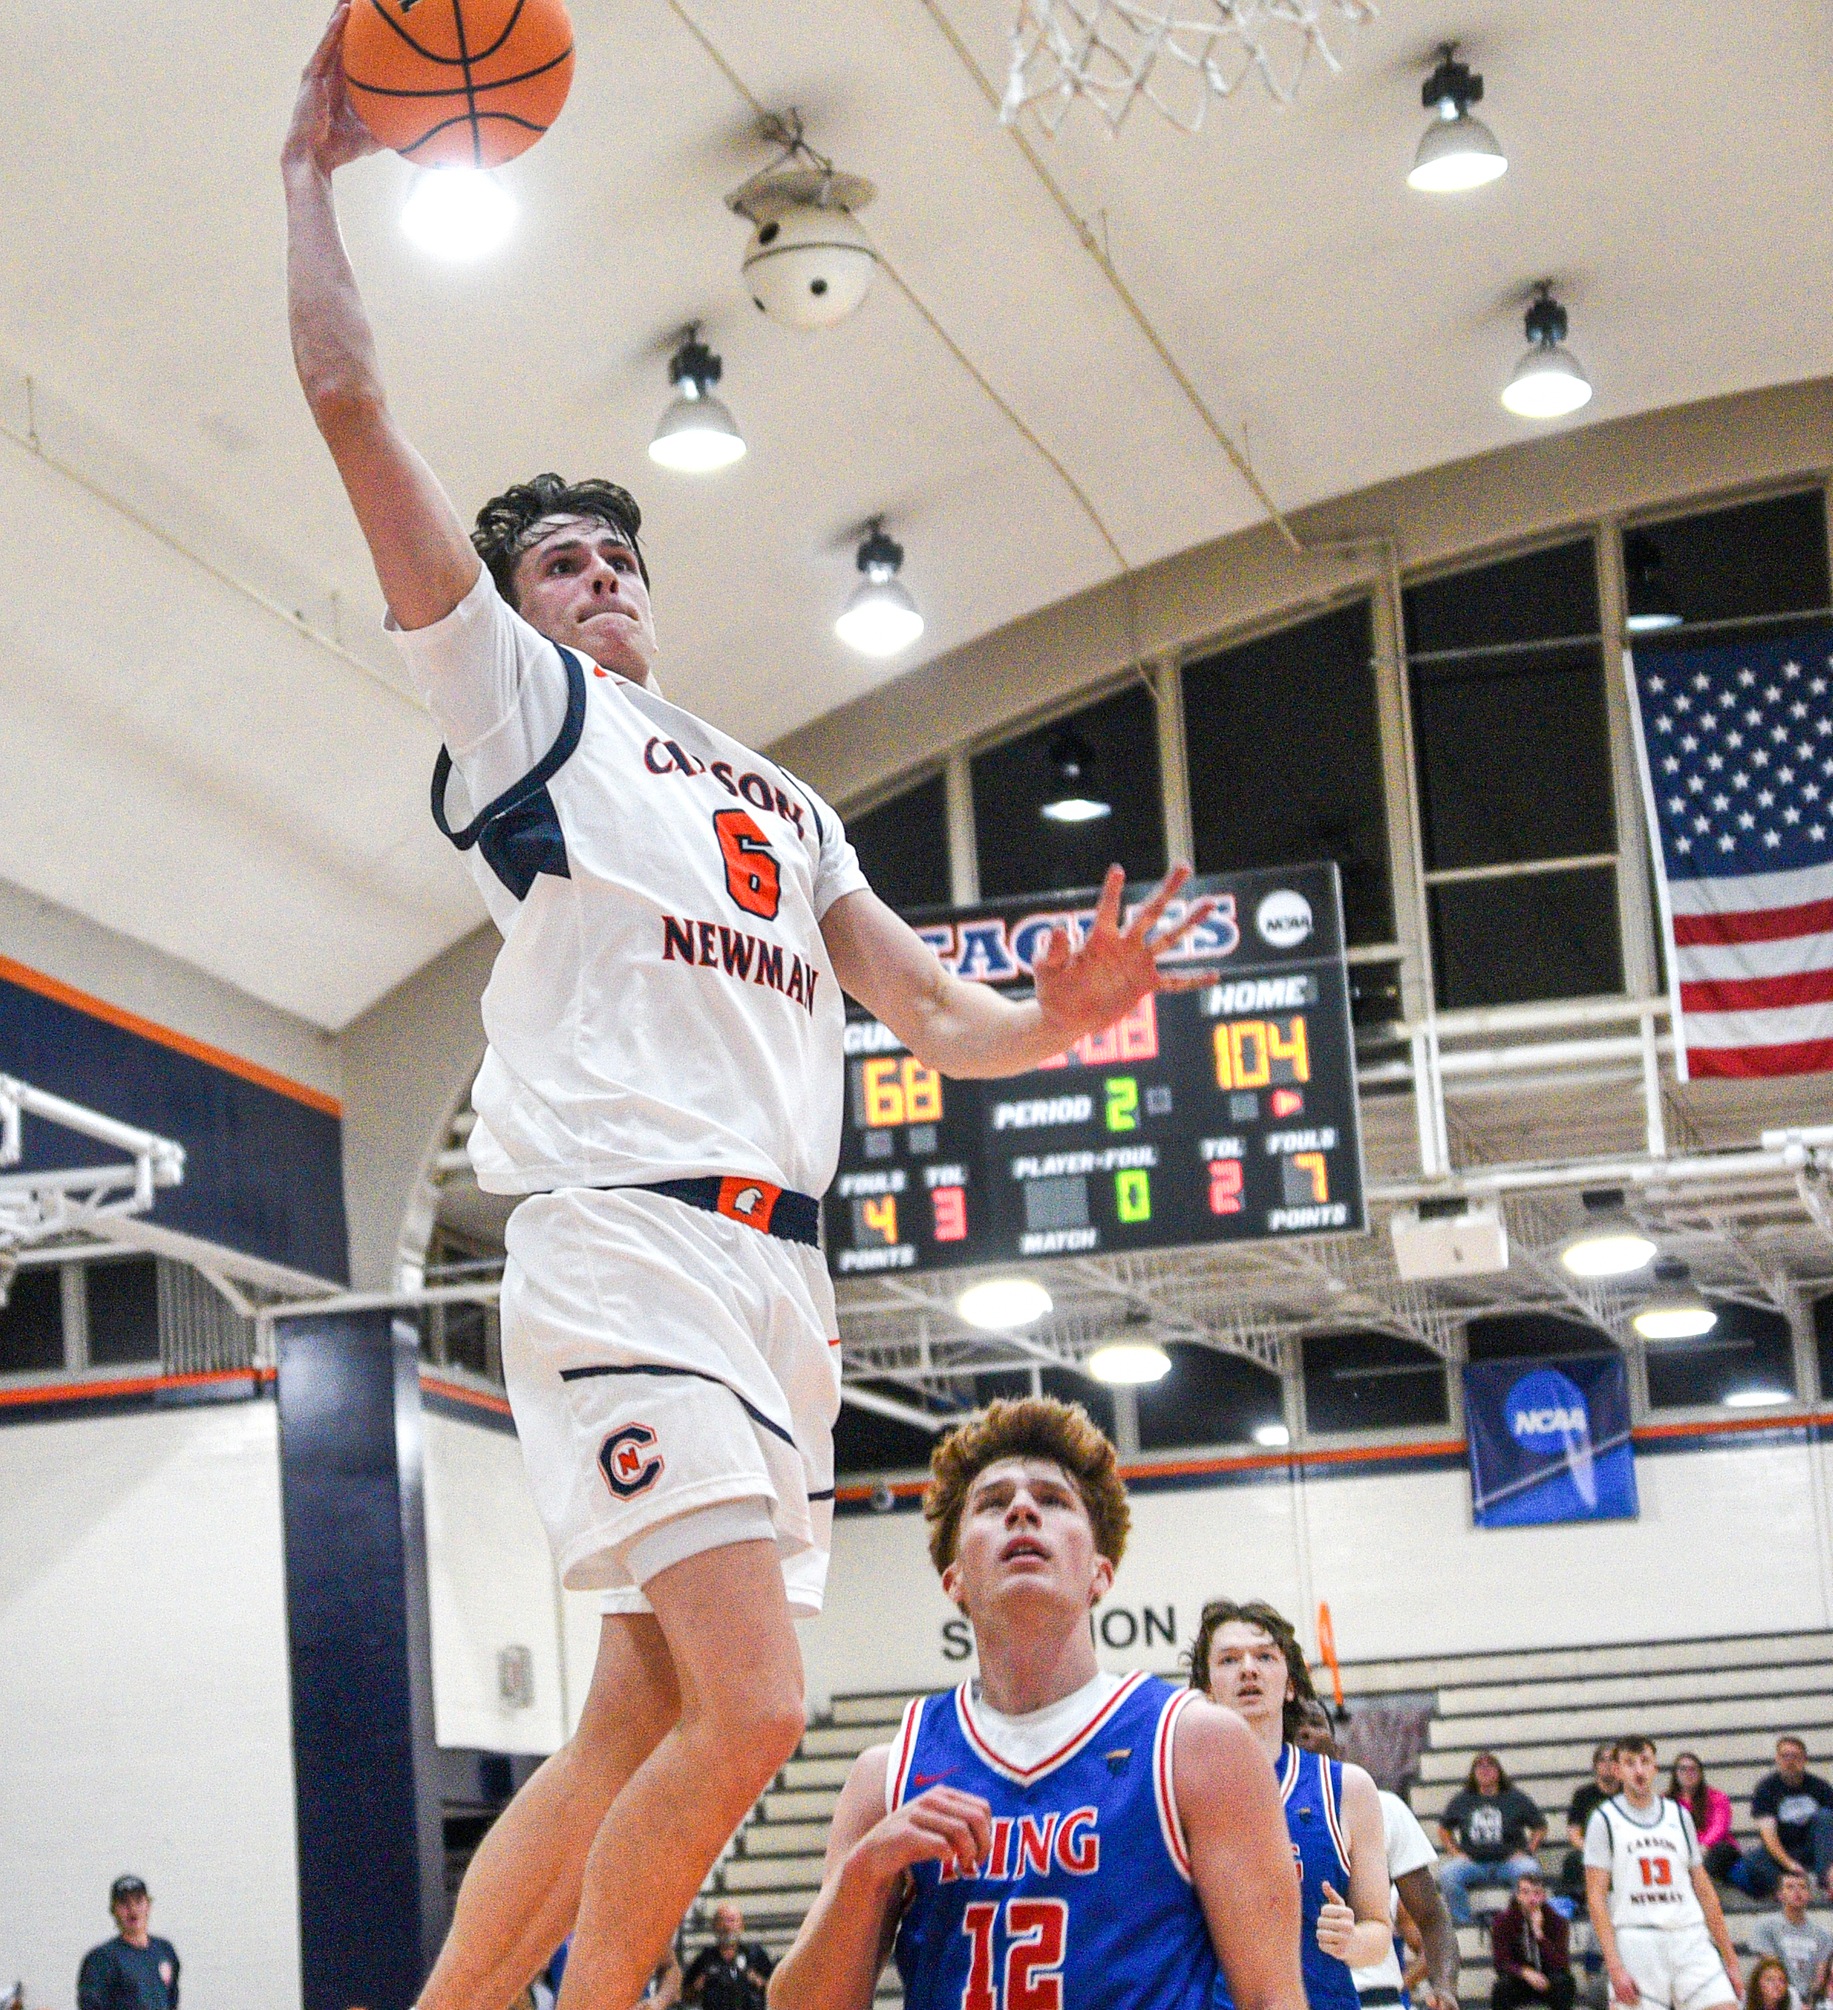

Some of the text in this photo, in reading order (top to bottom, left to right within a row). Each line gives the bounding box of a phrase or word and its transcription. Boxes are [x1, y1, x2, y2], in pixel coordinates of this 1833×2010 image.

[712, 808, 782, 921] 6
[661, 915, 820, 1016] NEWMAN
[1209, 974, 1308, 1016] HOME
[1213, 1015, 1311, 1089] 104
[863, 1057, 943, 1127] 68
[993, 1095, 1092, 1130] PERIOD
[1105, 1077, 1139, 1131] 2
[1266, 1127, 1337, 1154] FOULS
[1115, 1169, 1152, 1223] 0
[1208, 1158, 1243, 1215] 2
[1293, 1152, 1329, 1203] 7
[863, 1194, 899, 1245] 4
[932, 1186, 968, 1242] 3
[1268, 1203, 1348, 1231] POINTS
[1020, 1228, 1098, 1255] MATCH
[1515, 1407, 1588, 1435] NCAA
[1638, 1856, 1673, 1887] 13
[961, 1897, 1069, 2010] 12
